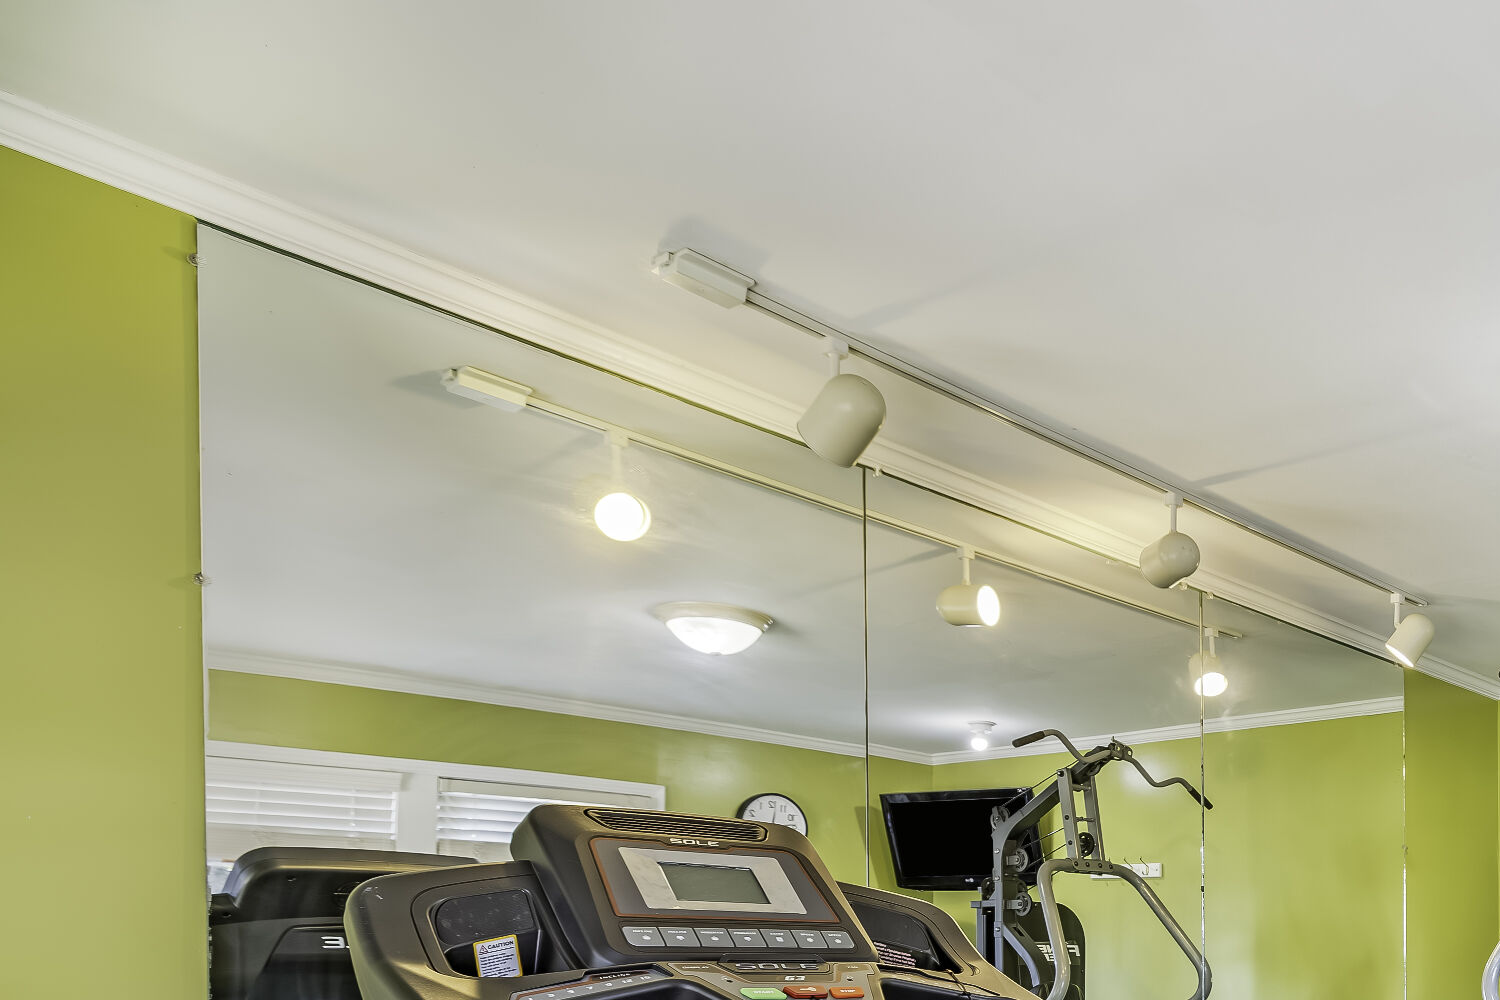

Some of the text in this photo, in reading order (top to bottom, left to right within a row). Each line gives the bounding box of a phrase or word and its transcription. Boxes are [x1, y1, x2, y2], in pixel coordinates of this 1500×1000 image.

[670, 838, 719, 847] SOLE
[487, 940, 514, 949] CAUTION
[735, 963, 819, 971] SOLE
